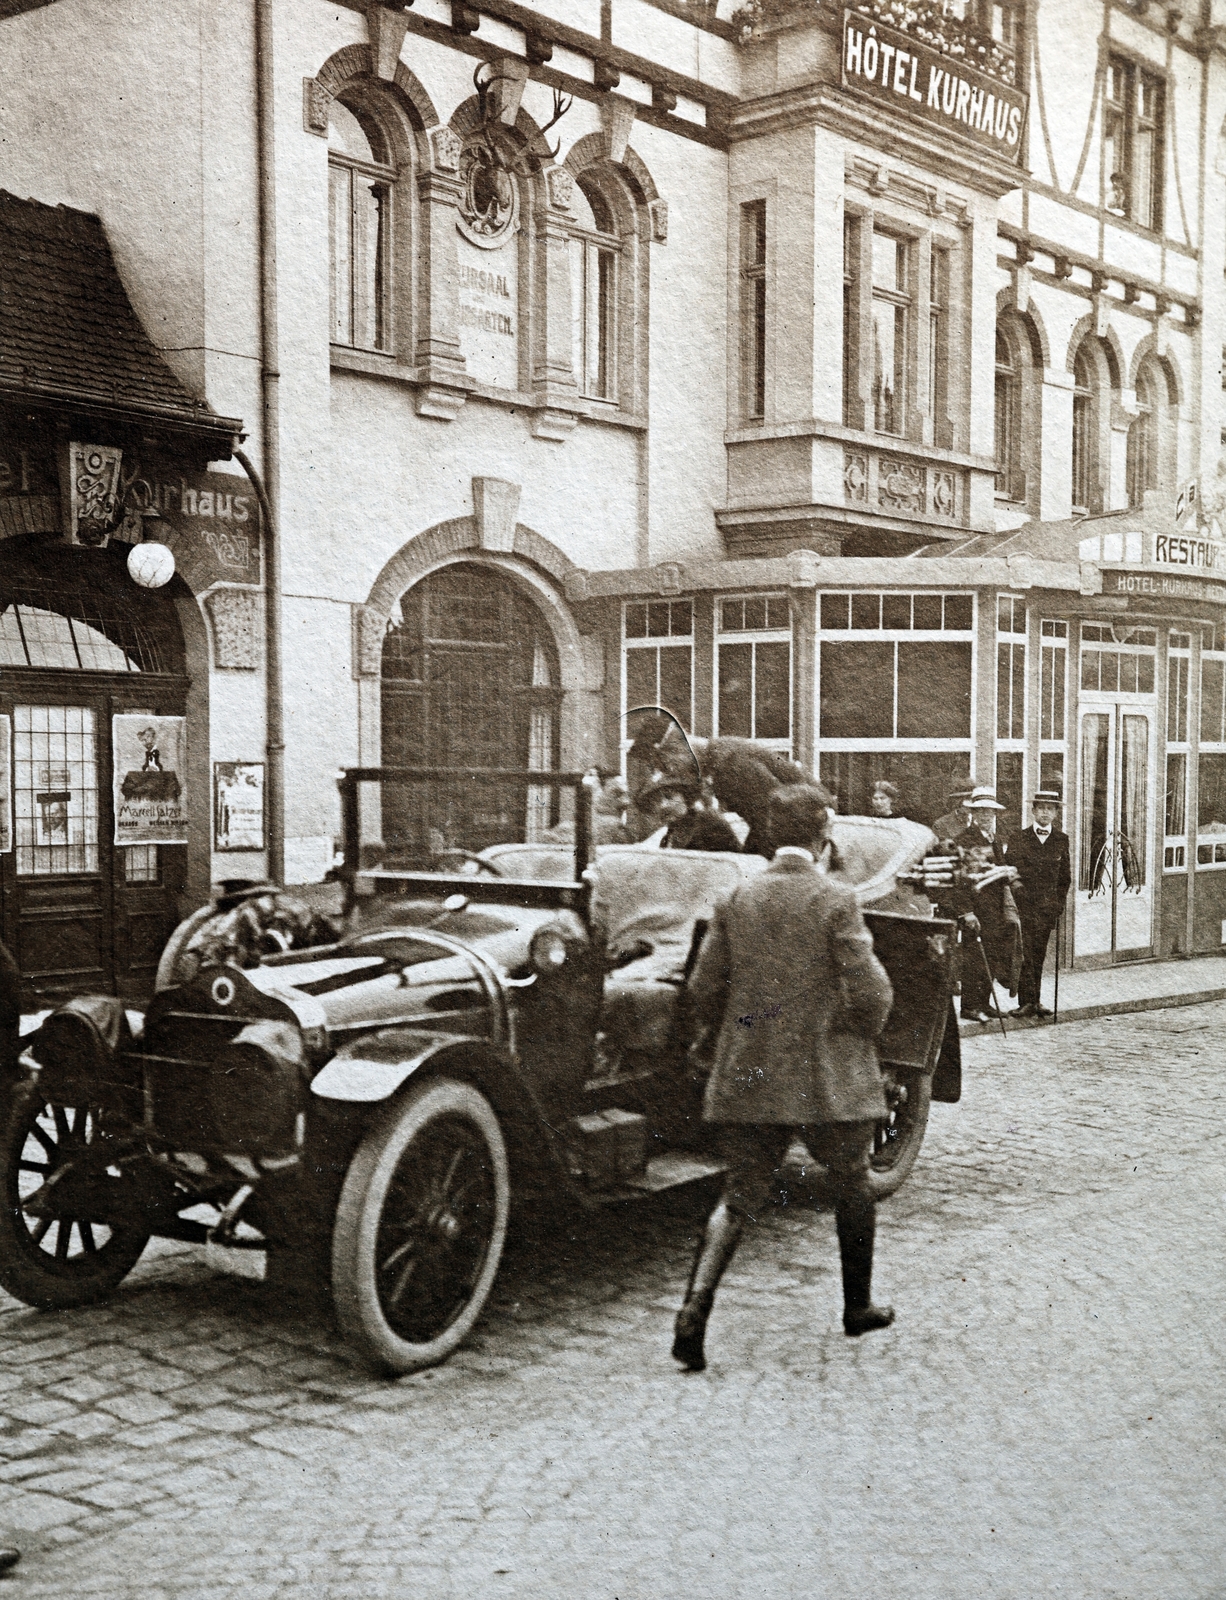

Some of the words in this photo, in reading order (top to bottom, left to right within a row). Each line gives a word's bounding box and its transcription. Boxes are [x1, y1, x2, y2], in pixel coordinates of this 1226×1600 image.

[846, 25, 922, 102] HÔTEL
[927, 65, 1021, 146] KURHAUS
[121, 463, 250, 523] Kurhaus
[1156, 534, 1223, 569] RESTAUR
